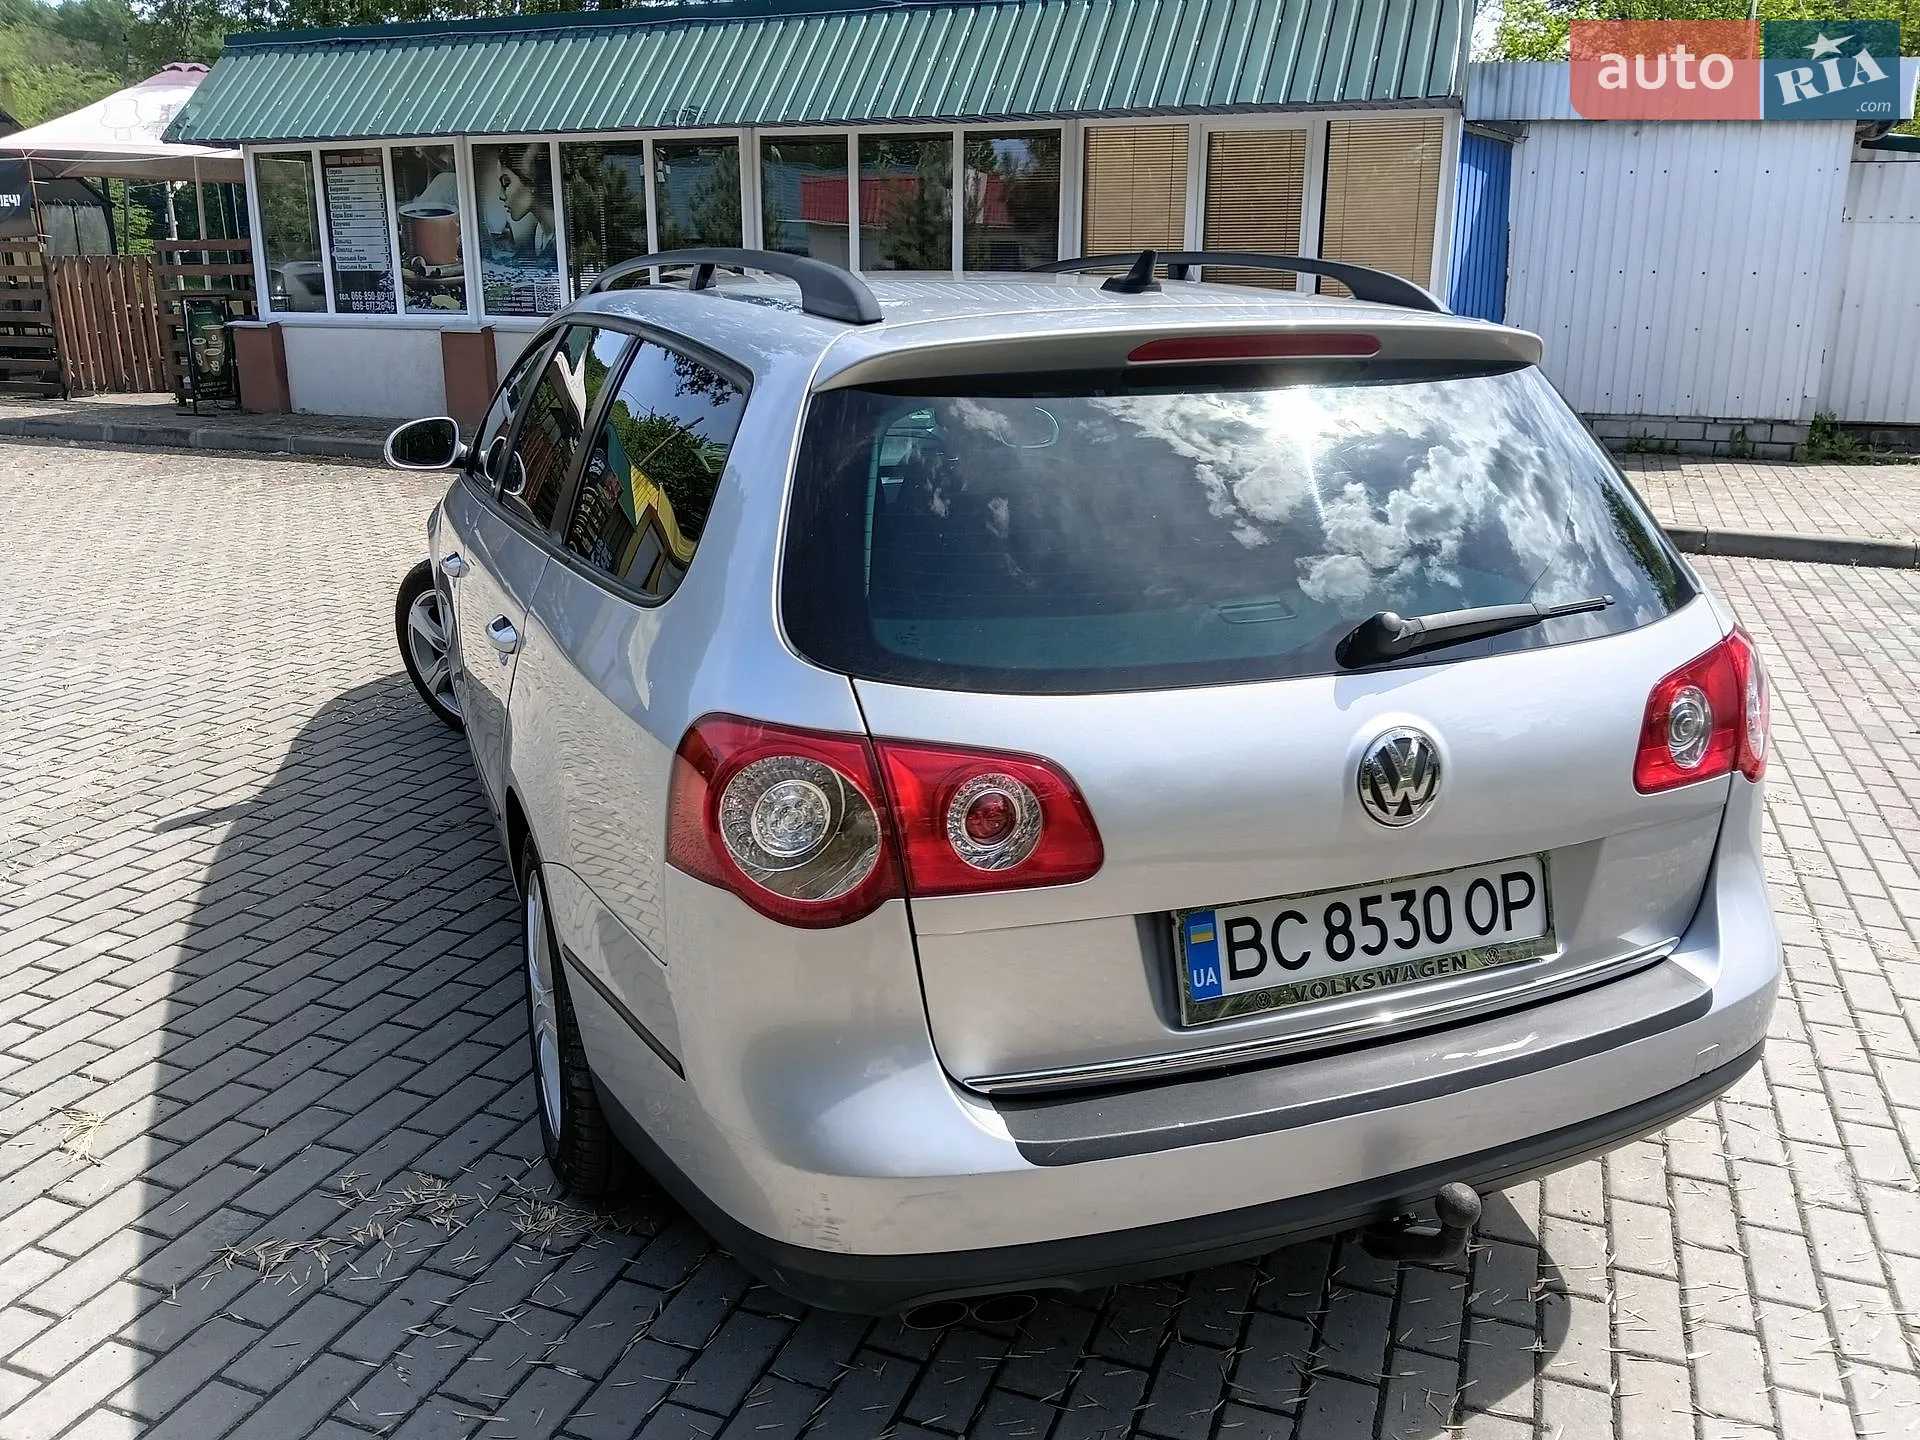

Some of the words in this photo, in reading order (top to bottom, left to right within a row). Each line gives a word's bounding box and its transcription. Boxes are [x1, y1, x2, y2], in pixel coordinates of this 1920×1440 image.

[1225, 909, 1312, 981] BC
[1323, 885, 1453, 963] 8530
[1465, 871, 1536, 936] OP
[1193, 967, 1218, 988] UA
[1290, 954, 1468, 1002] VOLKSWAGEN
